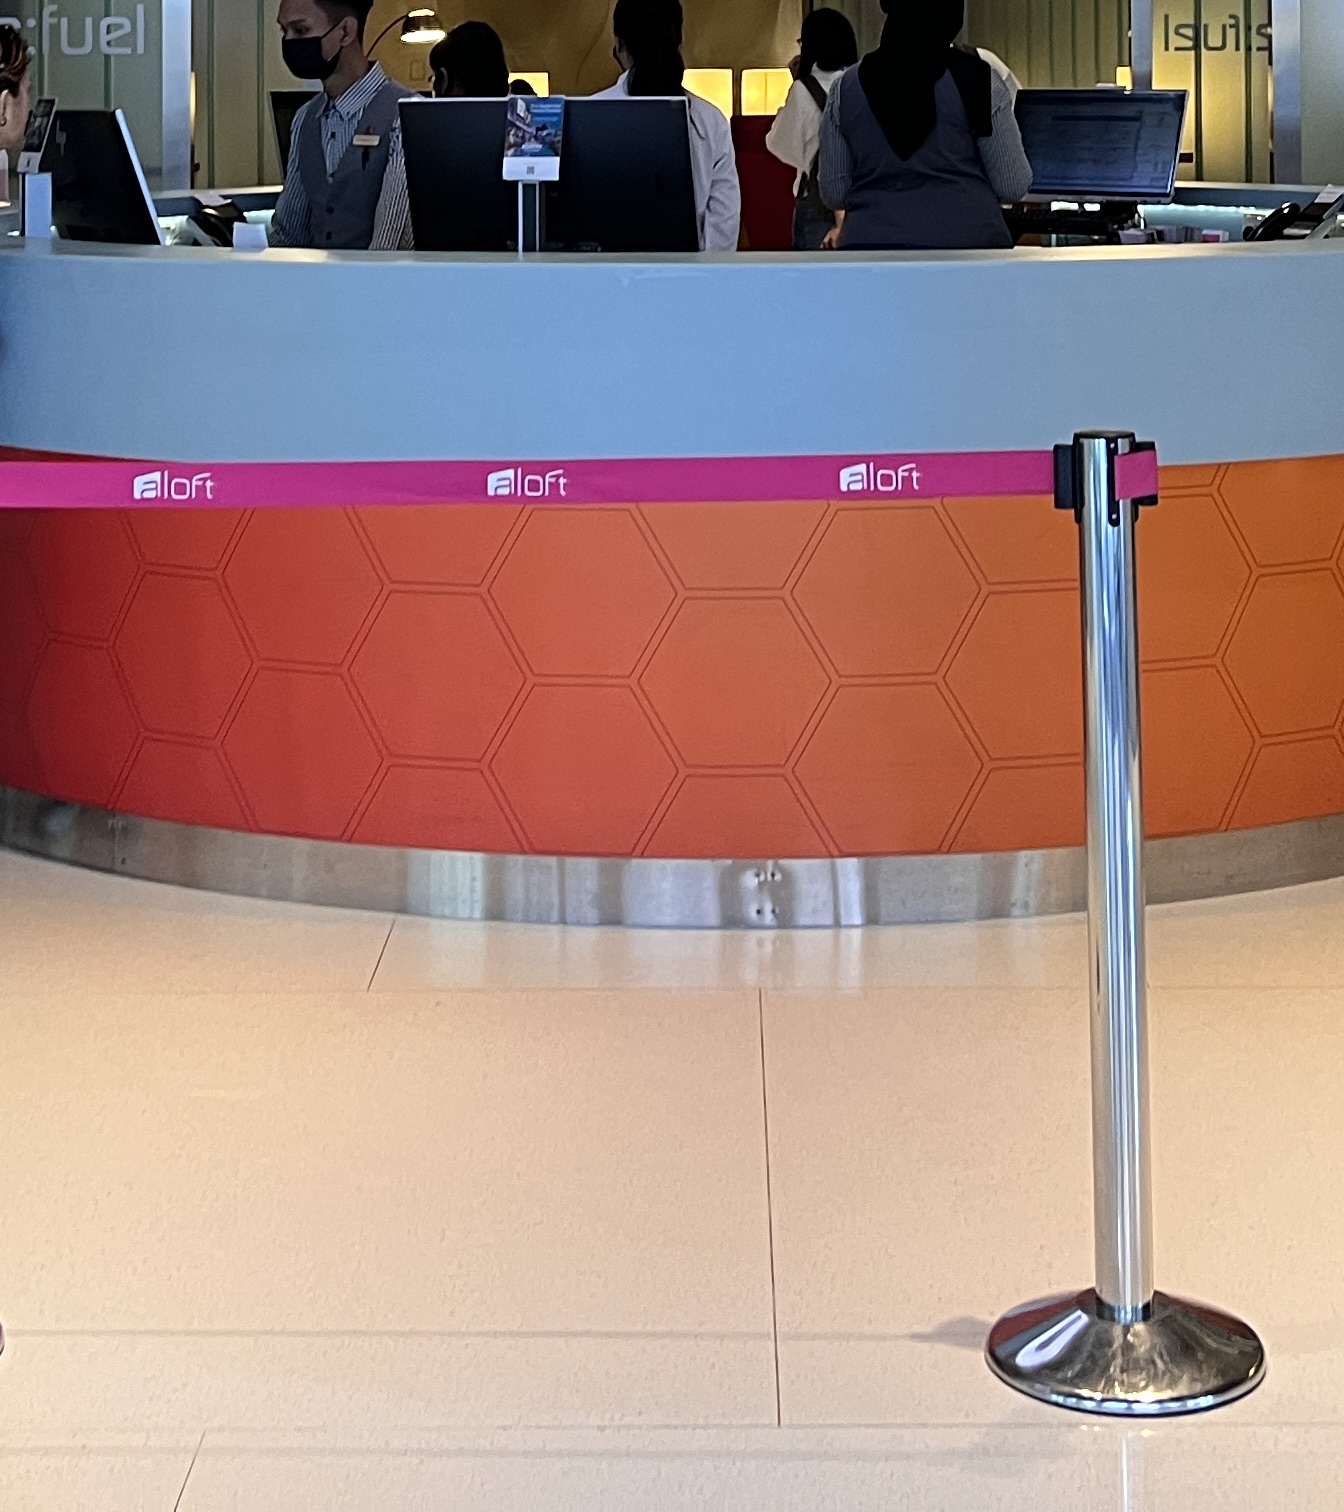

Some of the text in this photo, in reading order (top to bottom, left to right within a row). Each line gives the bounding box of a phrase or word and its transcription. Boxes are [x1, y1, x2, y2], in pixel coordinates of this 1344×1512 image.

[133, 469, 215, 500] aloft
[487, 467, 568, 497] aloft
[839, 461, 921, 492] aloft
